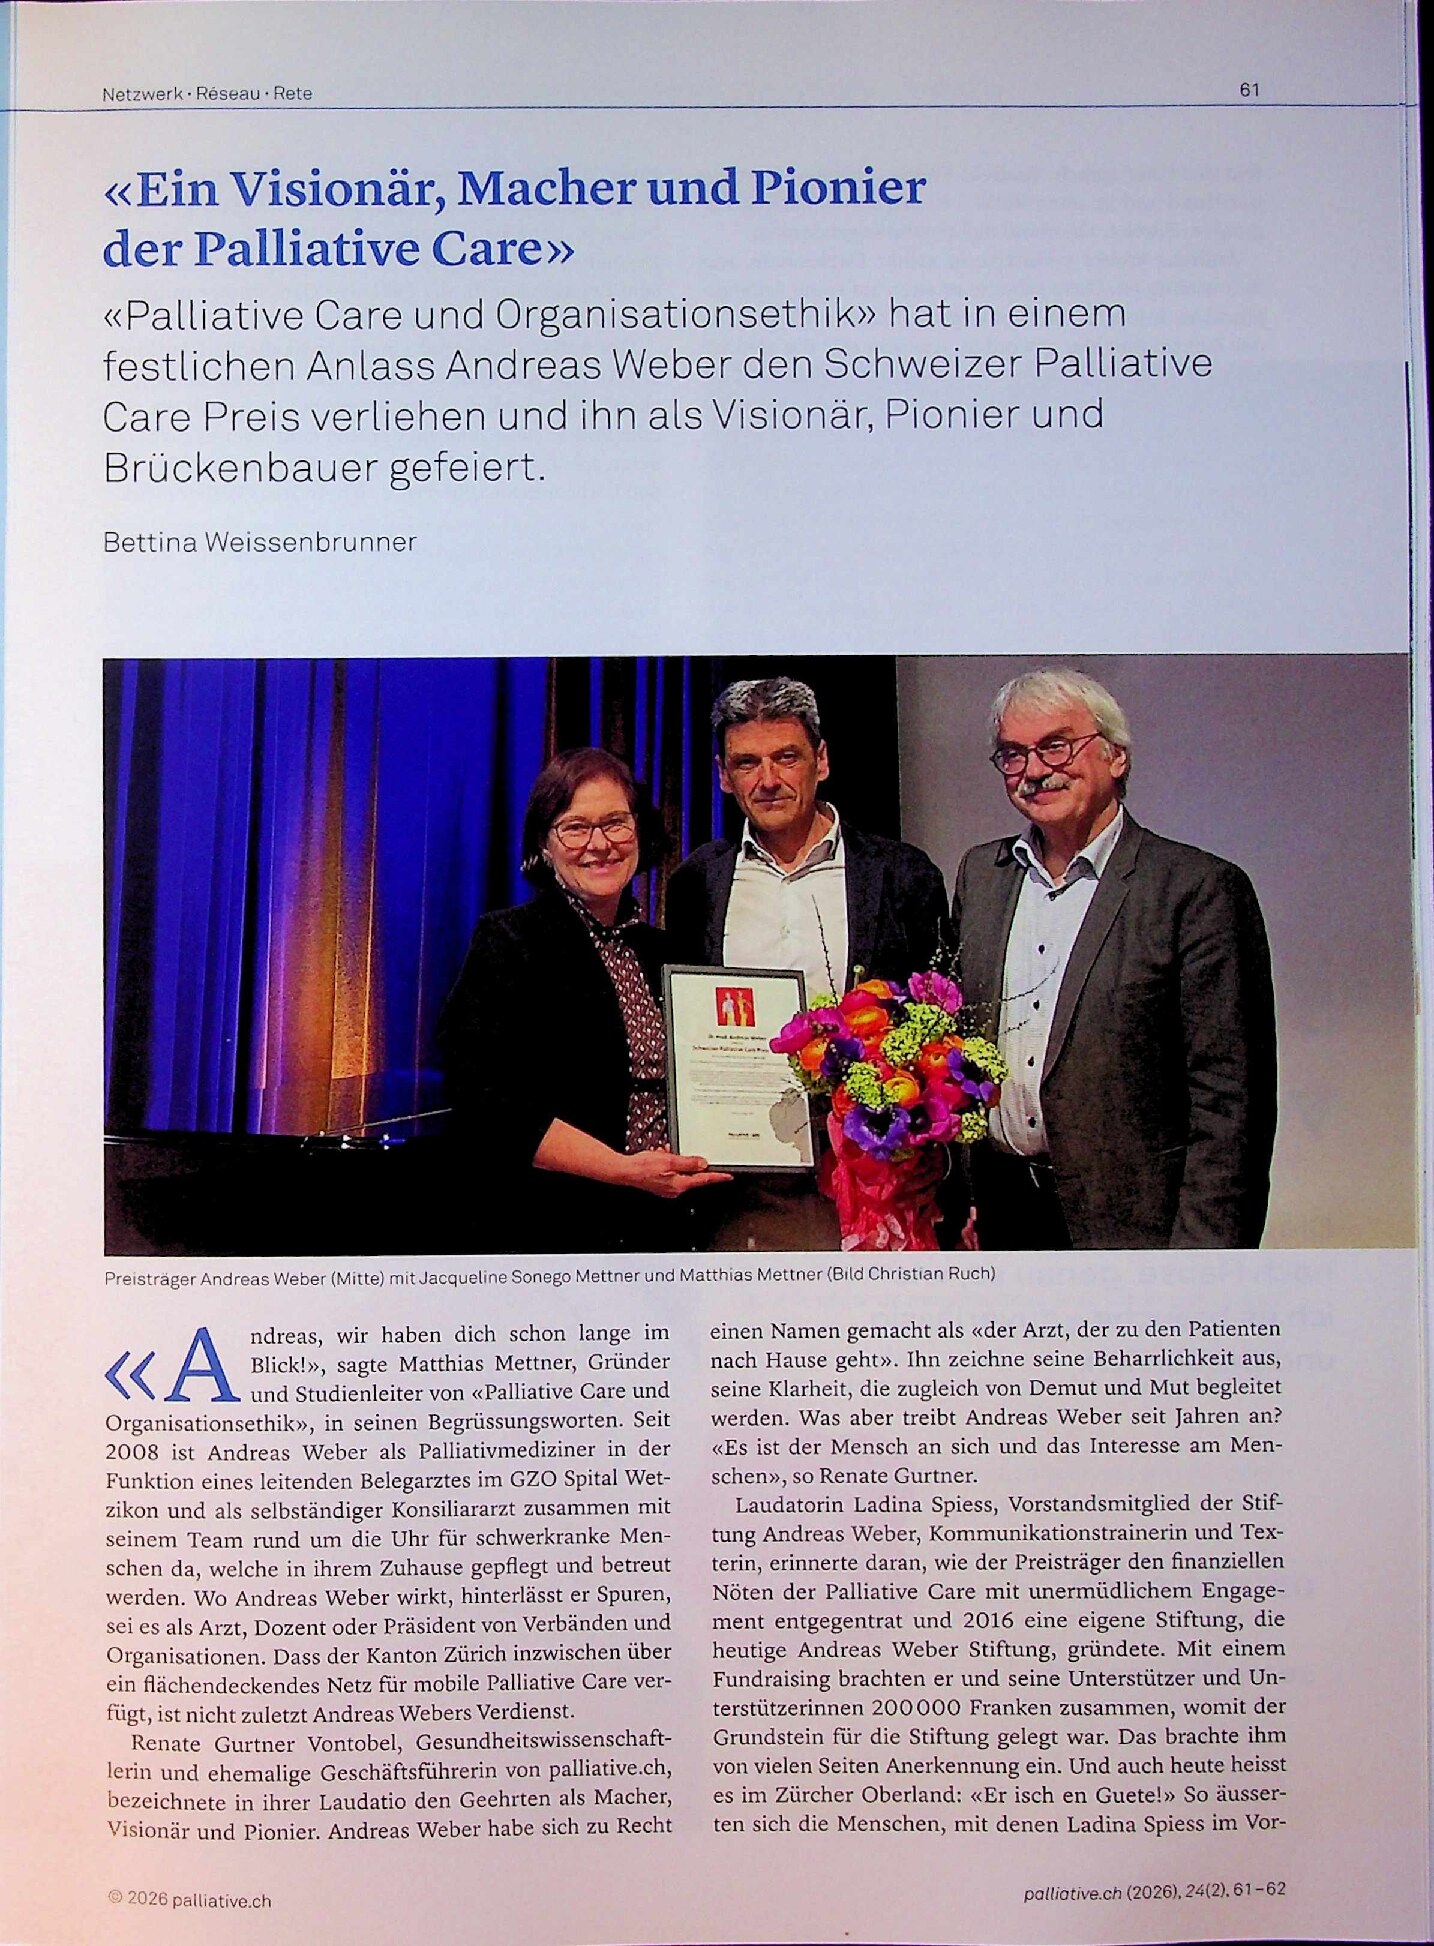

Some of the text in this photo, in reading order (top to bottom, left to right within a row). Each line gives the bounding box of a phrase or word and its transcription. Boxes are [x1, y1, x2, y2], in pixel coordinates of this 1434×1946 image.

[102, 84, 313, 103] Netzwerk Réseau Rete
[1239, 81, 1259, 98] 61
[104, 167, 221, 208] «Ein
[228, 167, 446, 217] Visionär,
[457, 166, 638, 206] Macher
[646, 165, 741, 206] und
[750, 165, 928, 206] Pionier
[103, 227, 575, 268] der Palliative Care»
[103, 296, 1126, 338] «Palliative Care und Organisationsethik» hat in einem
[102, 345, 1213, 382] festlichen Anlass Andreas Weber den Schweizer Palliative
[103, 396, 1103, 434] Care Preis verliehen und ihn als Visionär, Pionier und
[105, 449, 545, 491] Brückenbauer gefeiert.
[104, 530, 418, 553] Bettina Weissenbrunner
[103, 1263, 996, 1292] Preisträger Andreas Weber (Mitte) mit Jacqueline Sonego Mettner und Matthias Mettner (Bild Christian Ruch)
[336, 1326, 369, 1345] wir
[381, 1325, 442, 1344] haben
[454, 1323, 497, 1343] dich
[509, 1323, 567, 1343] schon
[578, 1323, 632, 1347] lange
[644, 1322, 670, 1341] im
[250, 1351, 671, 1379] Blick!», sagte Matthias Mettner, Gründer
[250, 1380, 671, 1403] und Studienleiter von «Palliative Care und
[710, 1376, 1283, 1402] seine Klarheit, die zugleich von Demut und Mut begleitet
[105, 1409, 671, 1437] Organisationsethik», in seinen Begrüssungsworten. Seit
[711, 1466, 978, 1489] schen», so Renate Gurtner.
[105, 1496, 672, 1525] zikon und als selbständiger Konsiliararzt zusammen mit
[711, 1550, 1285, 1576] terin, erinnerte daran, wie der Preisträger den finanziellen
[712, 1608, 1286, 1635] ment entgegentrat und 2016 eine eigene Stiftung, die
[106, 1641, 673, 1670] Organisationen. Dass der Kanton Zürich inzwischen über
[712, 1638, 1286, 1664] heutige Andreas Weber Stiftung, gründete. Mit einem
[106, 1672, 672, 1695] ein flächendeckendes Netz für mobile Palliative Care ver-
[107, 1757, 672, 1788] lerin und ehemalige Geschäftsführerin von palliative.ch,
[127, 1890, 168, 1906] 2026
[172, 1892, 272, 1910] palliative.ch
[1023, 1886, 1122, 1904] palliative.ch
[1127, 1883, 1182, 1902] (2026),
